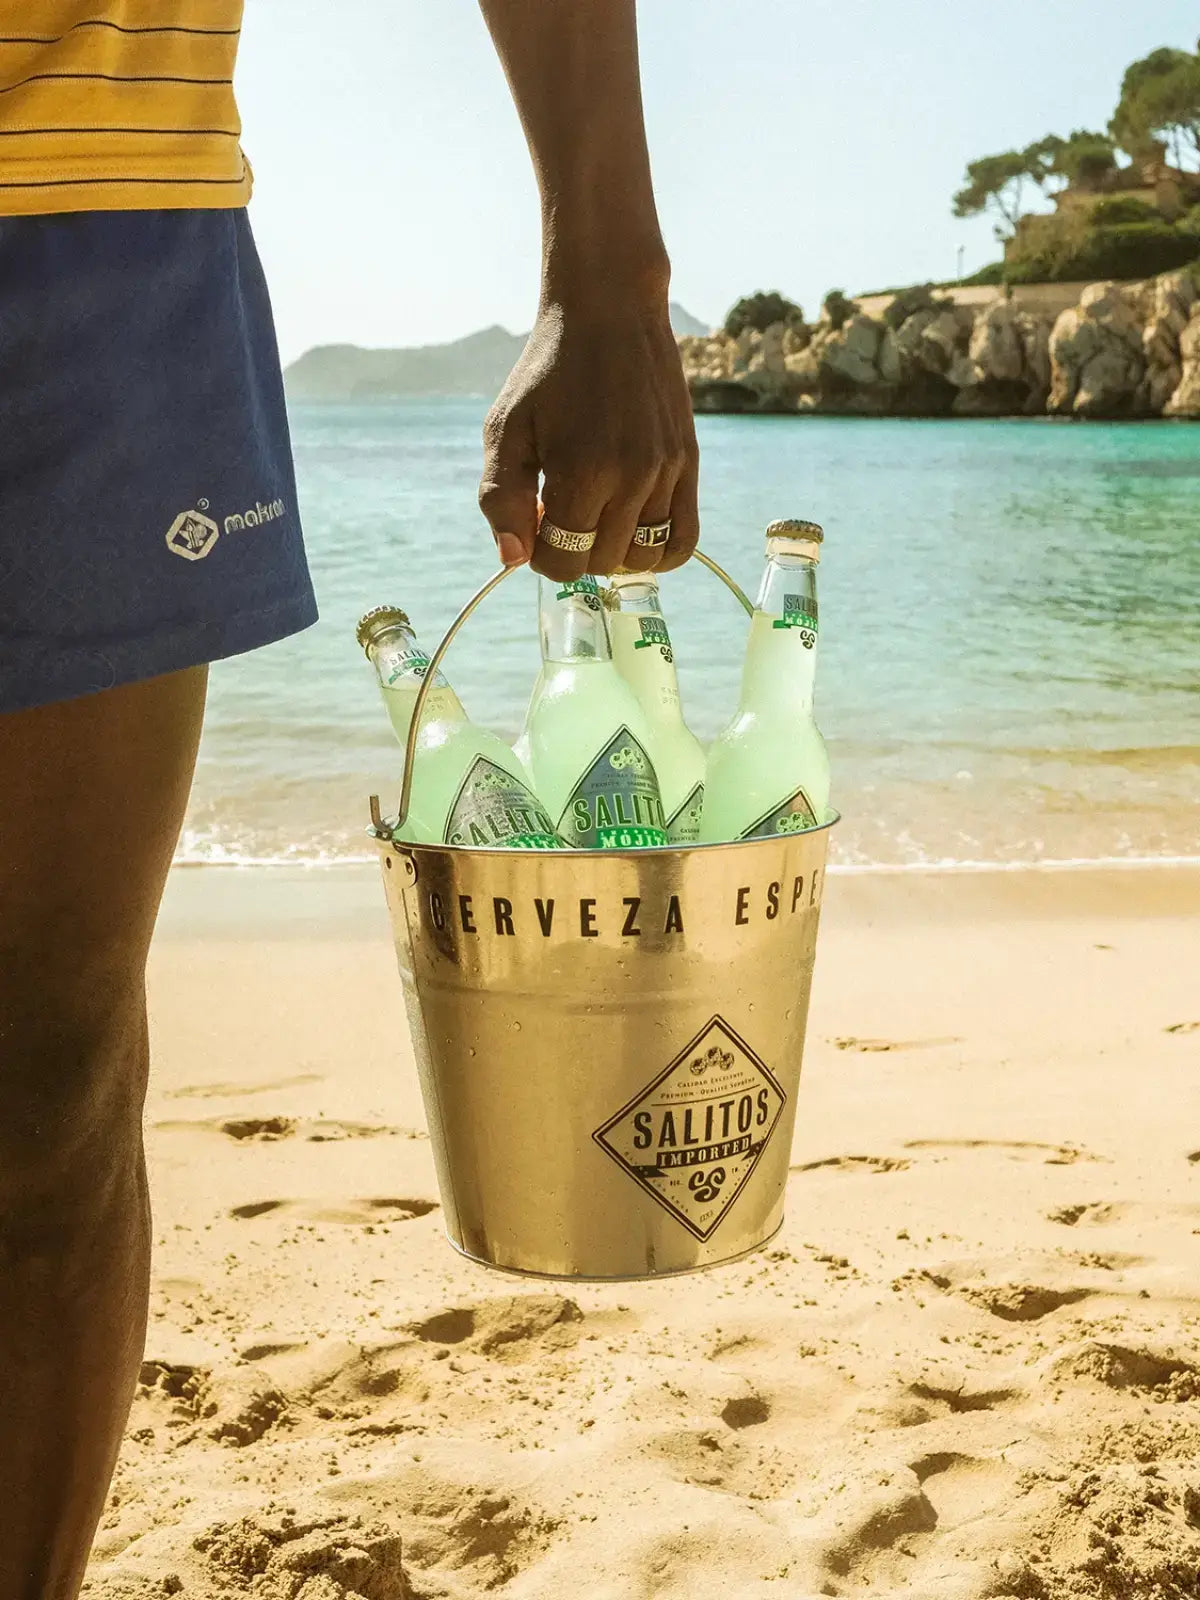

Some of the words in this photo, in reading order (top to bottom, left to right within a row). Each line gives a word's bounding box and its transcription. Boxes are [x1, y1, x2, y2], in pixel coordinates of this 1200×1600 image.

[429, 892, 685, 938] CERVEZA
[734, 868, 820, 926] ESPE
[633, 1088, 769, 1150] SALITOS
[660, 1137, 750, 1167] IMPORTED
